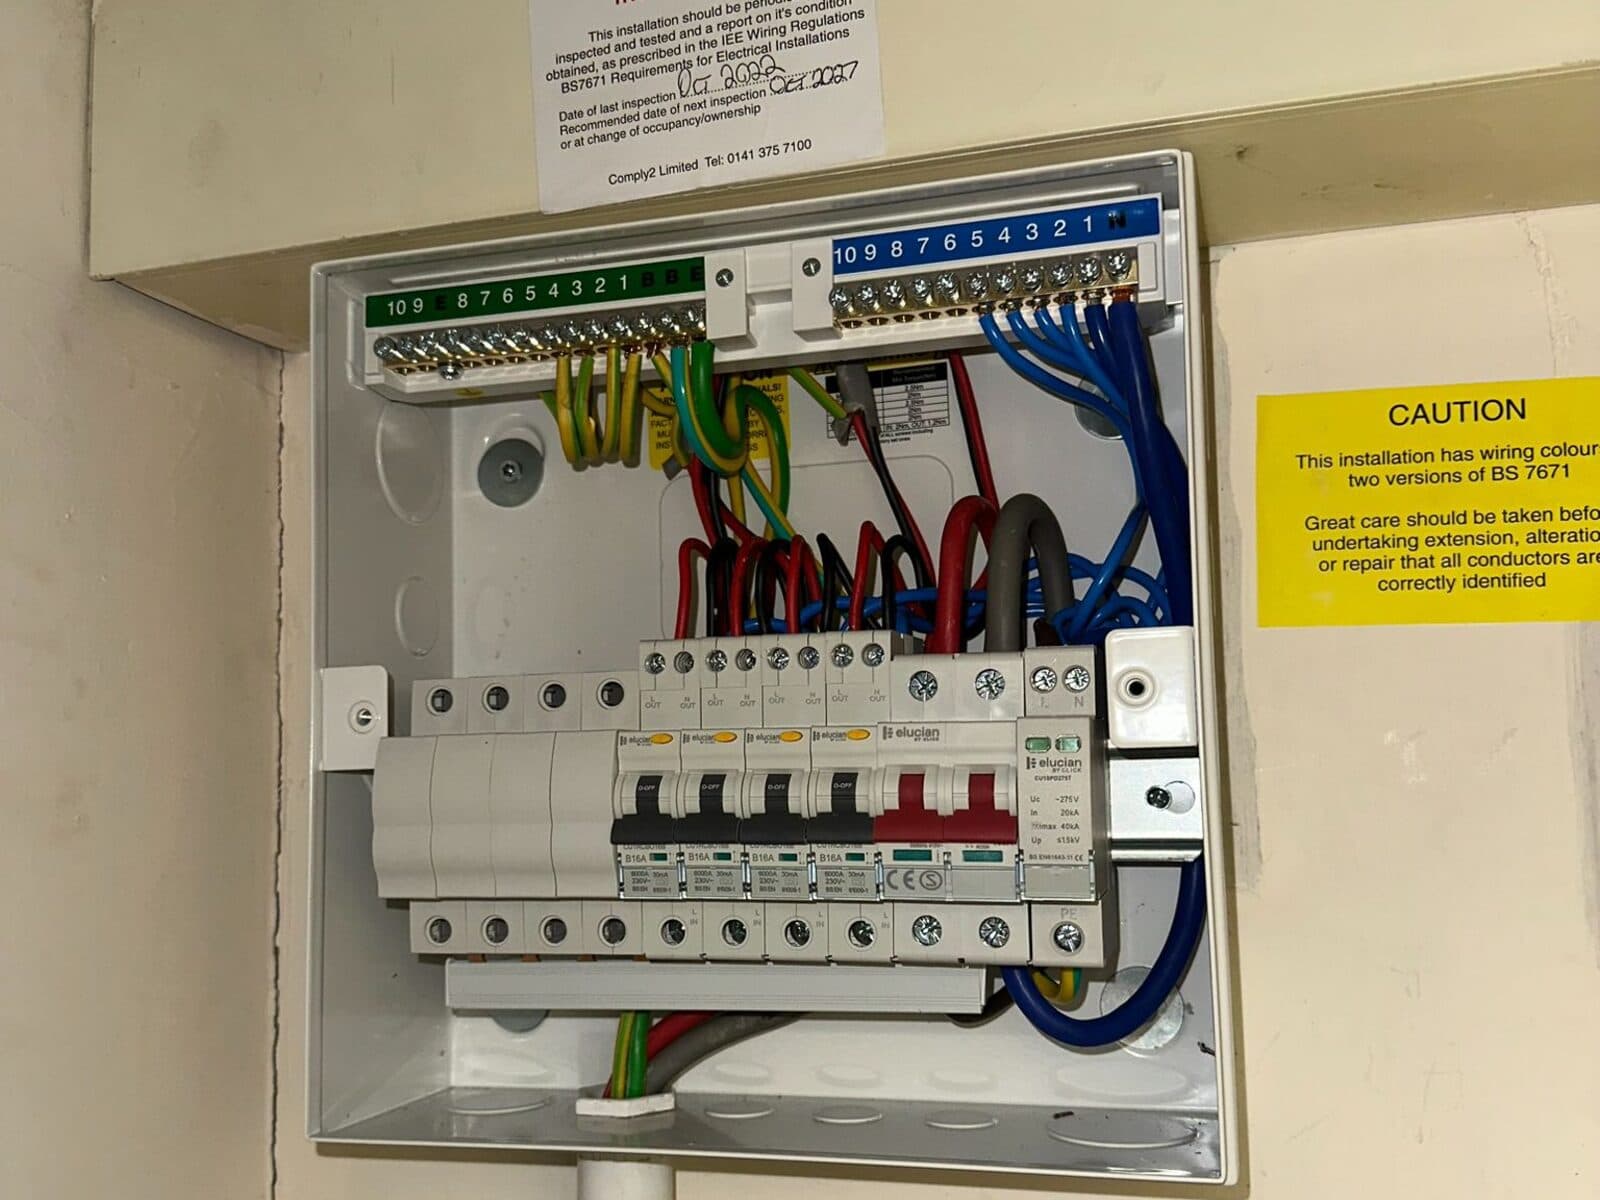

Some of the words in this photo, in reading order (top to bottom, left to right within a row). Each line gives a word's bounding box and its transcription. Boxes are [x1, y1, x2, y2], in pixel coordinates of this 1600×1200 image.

[556, 44, 611, 64] inspected
[614, 39, 636, 52] and
[640, 31, 676, 48] tested
[680, 24, 702, 40] and
[706, 25, 713, 34] a
[717, 16, 752, 32] report
[756, 12, 771, 24] on
[775, 8, 792, 20] it's
[588, 30, 614, 42] This
[616, 16, 679, 36] installation
[682, 8, 722, 23] should
[726, 4, 741, 14] be
[546, 62, 598, 82] obtained,
[602, 60, 616, 71] as
[620, 44, 682, 68] prescribed
[685, 40, 695, 53] in
[699, 38, 718, 50] the
[722, 32, 743, 46] IEE
[747, 24, 786, 40] Wiring
[790, 9, 865, 32] Regulations
[561, 75, 606, 94] BS7671
[611, 58, 693, 84] Requirements
[696, 55, 713, 68] for
[716, 43, 772, 63] Electrical
[776, 28, 850, 50] Installations
[720, 54, 786, 89] 2022
[812, 60, 859, 88] 2027
[559, 109, 584, 122] Date
[586, 106, 597, 117] of
[600, 102, 619, 114] last
[622, 91, 676, 110] inspection
[560, 112, 640, 136] Recommended
[643, 108, 667, 121] date
[670, 104, 680, 114] of
[684, 100, 707, 112] next
[710, 88, 766, 107] inspection
[560, 140, 571, 150] or
[574, 137, 584, 148] at
[587, 129, 627, 145] change
[630, 126, 640, 137] of
[643, 104, 761, 134] occupancy/ownership
[608, 167, 656, 185] Comply2
[659, 159, 698, 176] Limited
[704, 154, 724, 168] Tel:
[727, 150, 754, 164] 0141
[759, 145, 780, 158] 375
[783, 139, 812, 153] 7100
[834, 246, 856, 264] 10
[864, 244, 876, 260] 9
[891, 241, 903, 257] 8
[917, 237, 930, 254] 7
[944, 234, 957, 251] 6
[971, 230, 983, 247] 5
[998, 227, 1011, 243] 4
[1026, 223, 1039, 240] 3
[1054, 220, 1067, 237] 2
[1083, 215, 1092, 233] 1
[388, 300, 406, 316] 10
[413, 298, 423, 313] 9
[458, 293, 468, 308] 8
[480, 291, 490, 306] 7
[503, 288, 513, 303] 6
[526, 285, 536, 300] 5
[548, 283, 559, 298] 4
[572, 280, 582, 296] 3
[595, 278, 606, 293] 2
[620, 275, 627, 290] 1
[1389, 398, 1526, 426] CAUTION
[1296, 454, 1333, 469] This
[1339, 449, 1434, 467] installation
[1441, 448, 1474, 462] has
[1480, 445, 1534, 462] wiring
[1540, 442, 1600, 458] colour
[1349, 474, 1380, 487] two
[1386, 469, 1462, 486] versions
[1468, 466, 1486, 482] of
[1492, 465, 1518, 481] BS
[1525, 463, 1569, 480] 7671
[1305, 515, 1355, 531] Great
[1361, 516, 1400, 529] care
[1407, 510, 1467, 526] should
[1474, 510, 1496, 524] be
[1502, 508, 1553, 524] taken
[1312, 534, 1418, 551] undertaking
[1425, 530, 1519, 547] extension,
[1319, 559, 1337, 572] or
[1343, 555, 1395, 574] repair
[1400, 554, 1435, 569] that
[1441, 553, 1461, 568] all
[1468, 551, 1570, 567] conductors
[1577, 552, 1600, 564] are
[1378, 575, 1456, 594] correctly
[1462, 572, 1546, 589] identified
[1074, 696, 1084, 707] N
[896, 727, 940, 738] elucian
[1039, 757, 1082, 767] elucian
[1032, 837, 1042, 845] Up
[752, 854, 774, 862] B16A
[820, 854, 842, 862] B16A
[1061, 908, 1077, 920] PE
